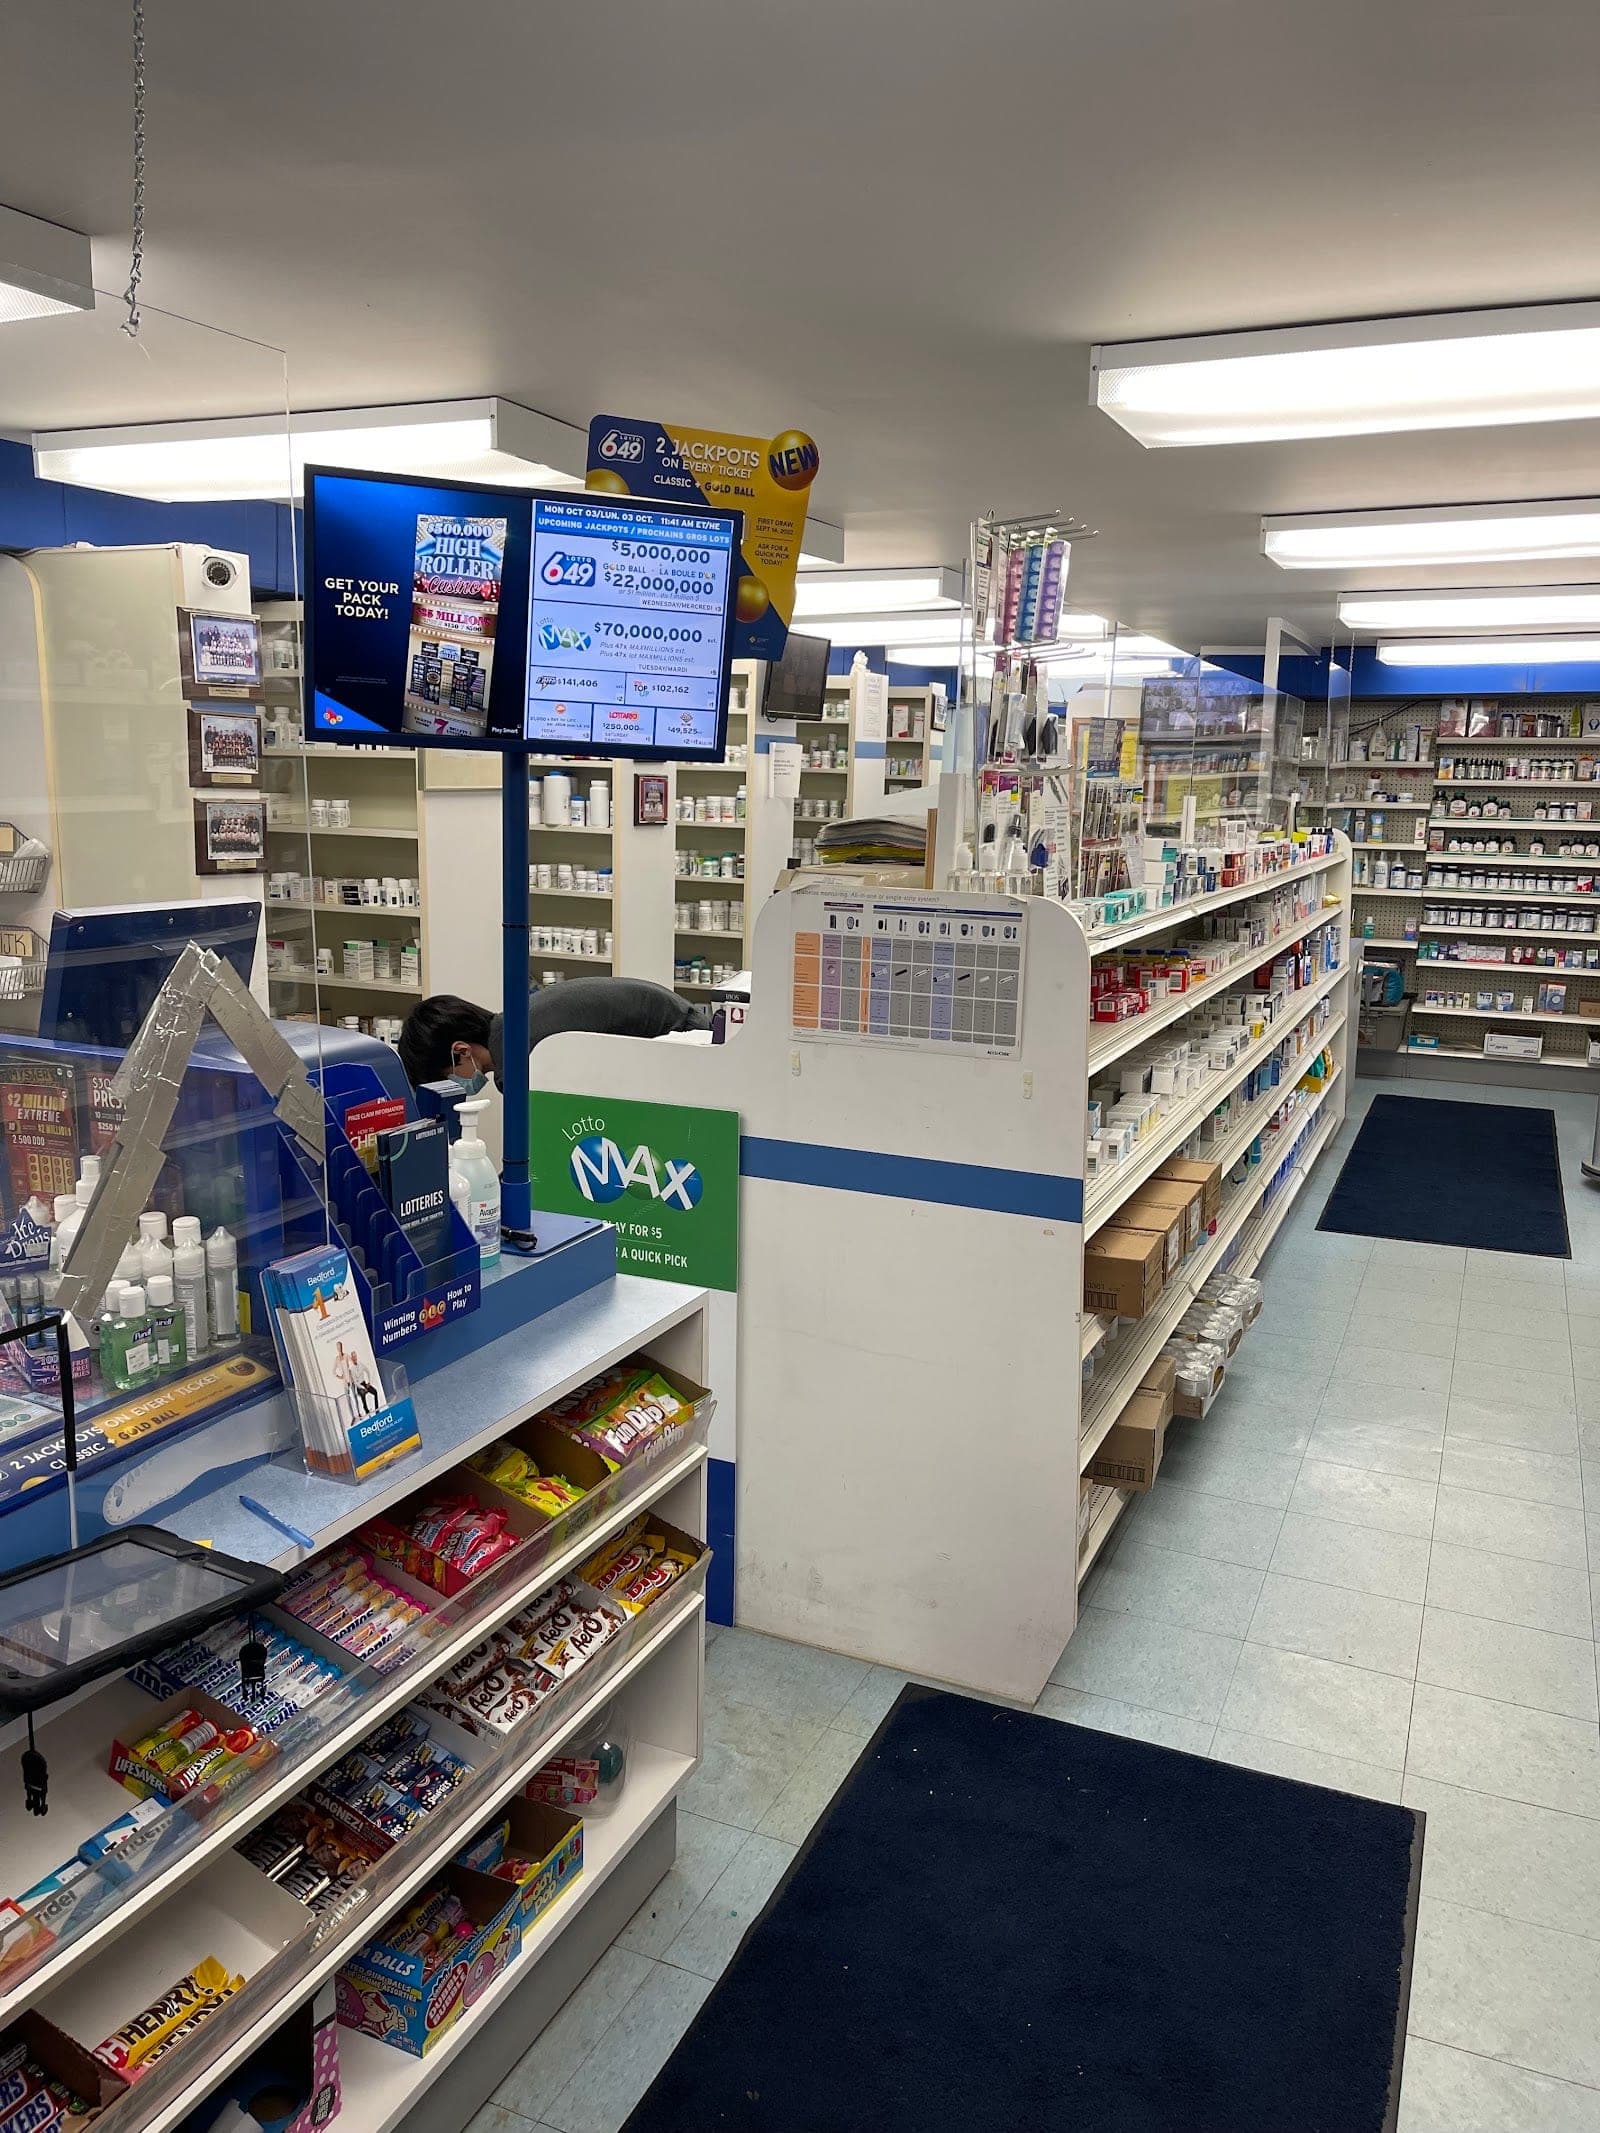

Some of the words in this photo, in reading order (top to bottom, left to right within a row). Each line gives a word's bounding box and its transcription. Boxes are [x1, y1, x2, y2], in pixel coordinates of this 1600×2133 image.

[602, 433, 641, 460] 649
[619, 434, 641, 443] LOTTO
[655, 437, 665, 454] 2
[672, 439, 760, 467] JACKPOTS
[769, 443, 819, 478] NEW
[662, 457, 679, 469] ON
[682, 459, 715, 473] EVERY
[718, 464, 752, 479] TICKET
[653, 474, 691, 488] CLASSIC
[734, 485, 755, 497] BALL
[544, 505, 565, 514] MON
[566, 507, 582, 517] OCT
[622, 513, 633, 522] 03
[660, 517, 679, 526] 11:41
[680, 519, 694, 527] AM
[538, 518, 583, 529] UPCOMING
[585, 523, 629, 534] JACKPOTS
[637, 527, 684, 540] PROCHAINS
[686, 533, 708, 542] GROS
[709, 535, 730, 544] LOTS
[435, 537, 481, 558] HIGH
[611, 540, 710, 564] $5,000,000
[420, 556, 494, 580] ROLLER
[543, 552, 594, 586] 649
[628, 565, 647, 574] BALL
[659, 567, 669, 576] LA
[671, 569, 697, 578] BOULE
[325, 578, 354, 590] GET
[358, 580, 399, 594] YOUR
[427, 575, 481, 596] Casino
[604, 572, 714, 595] $22,000,000
[343, 592, 381, 606] PACK
[335, 604, 389, 619] TODAY!
[540, 625, 591, 651] MAX
[594, 622, 702, 643] $70,000,000
[491, 727, 502, 735] Play
[17, 1108, 61, 1123] EXTREME
[562, 1115, 606, 1142] Lotto
[571, 1137, 696, 1211] MAX
[400, 1189, 444, 1217] LOTTERIES
[629, 1224, 649, 1237] FOR
[651, 1227, 662, 1239] $5
[631, 1249, 662, 1264] QUICK
[664, 1254, 688, 1268] PICK
[307, 1267, 337, 1287] Bedford
[447, 1288, 463, 1301] How
[464, 1284, 472, 1293] to
[452, 1298, 467, 1312] Play
[383, 1311, 415, 1331] Winning
[382, 1323, 418, 1345] Numbers
[10, 1461, 25, 1470] 2
[104, 1413, 128, 1429] ON
[130, 1393, 177, 1416] EVERY
[175, 1373, 219, 1396] TICKET
[152, 1409, 180, 1426] BALL
[360, 1413, 394, 1438] Bedford
[605, 1421, 638, 1454] Fun
[624, 1404, 666, 1432] Dip
[331, 1608, 374, 1643] entos
[115, 1755, 169, 1796] LIFESAVERS
[184, 1746, 226, 1788] LIFESAVERS
[314, 1791, 364, 1833] GAGNEZ!
[372, 1950, 416, 1977] BALLS
[119, 1974, 202, 2046] HENRY
